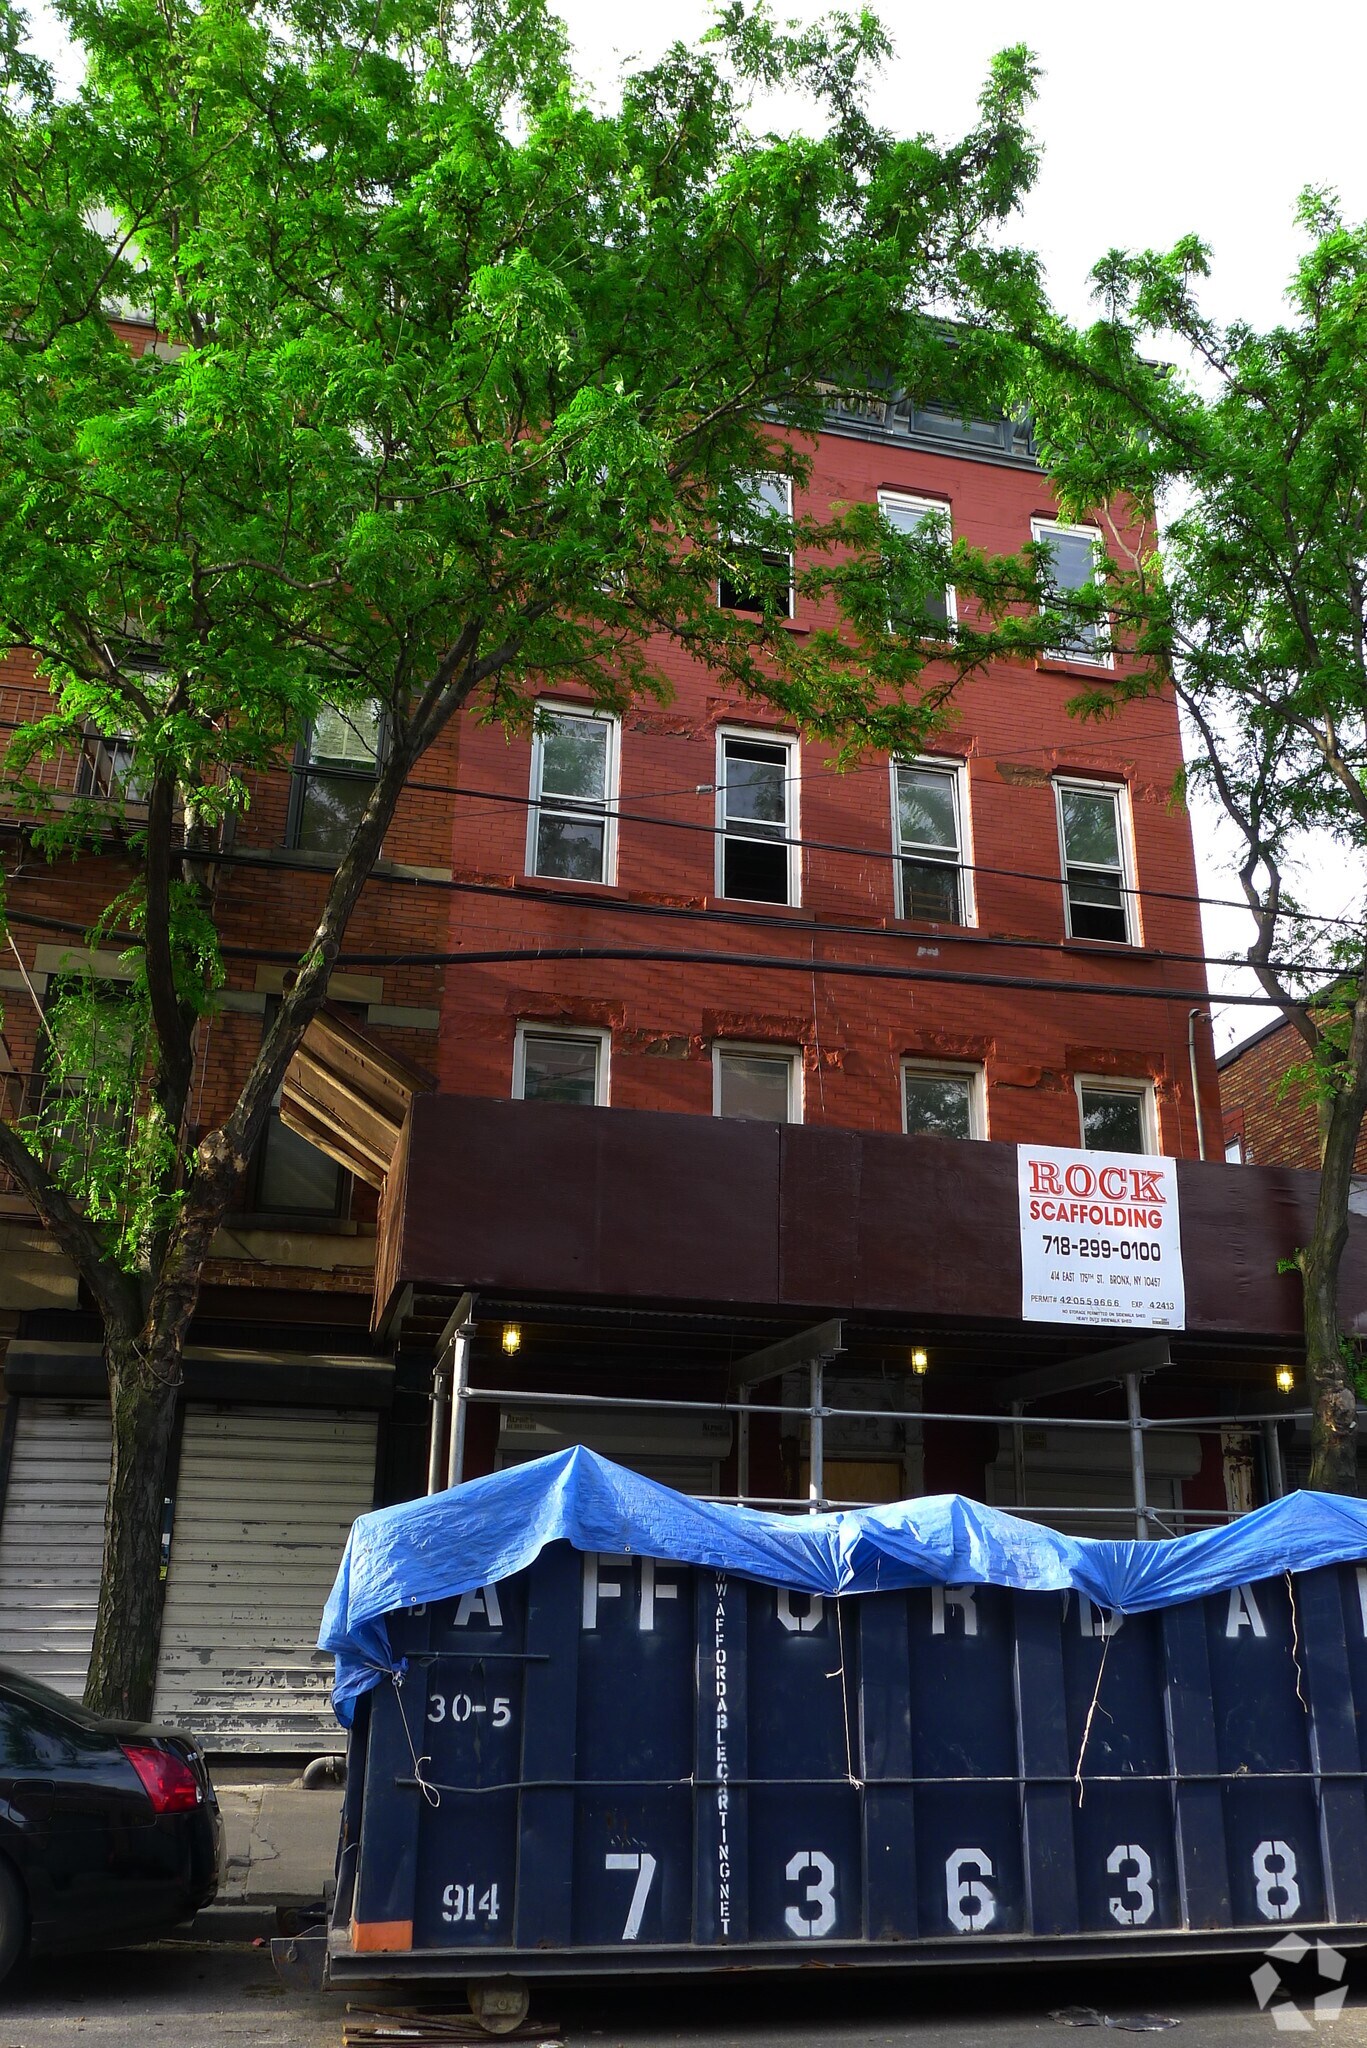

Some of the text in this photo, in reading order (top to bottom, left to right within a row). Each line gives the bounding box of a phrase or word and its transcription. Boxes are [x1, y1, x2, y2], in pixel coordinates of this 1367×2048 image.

[1028, 1160, 1167, 1204] ROCK
[1030, 1200, 1162, 1229] SCAFFOLDING
[1042, 1235, 1161, 1262] 718-299-0100
[1062, 1272, 1074, 1282] EAST
[1110, 1275, 1131, 1286] BRONX,
[1134, 1276, 1141, 1286] NY
[1144, 1276, 1160, 1287] 10457
[1031, 1295, 1057, 1303] PERMIT#
[427, 1694, 511, 1727] 30-5
[442, 1883, 500, 1922] 914
